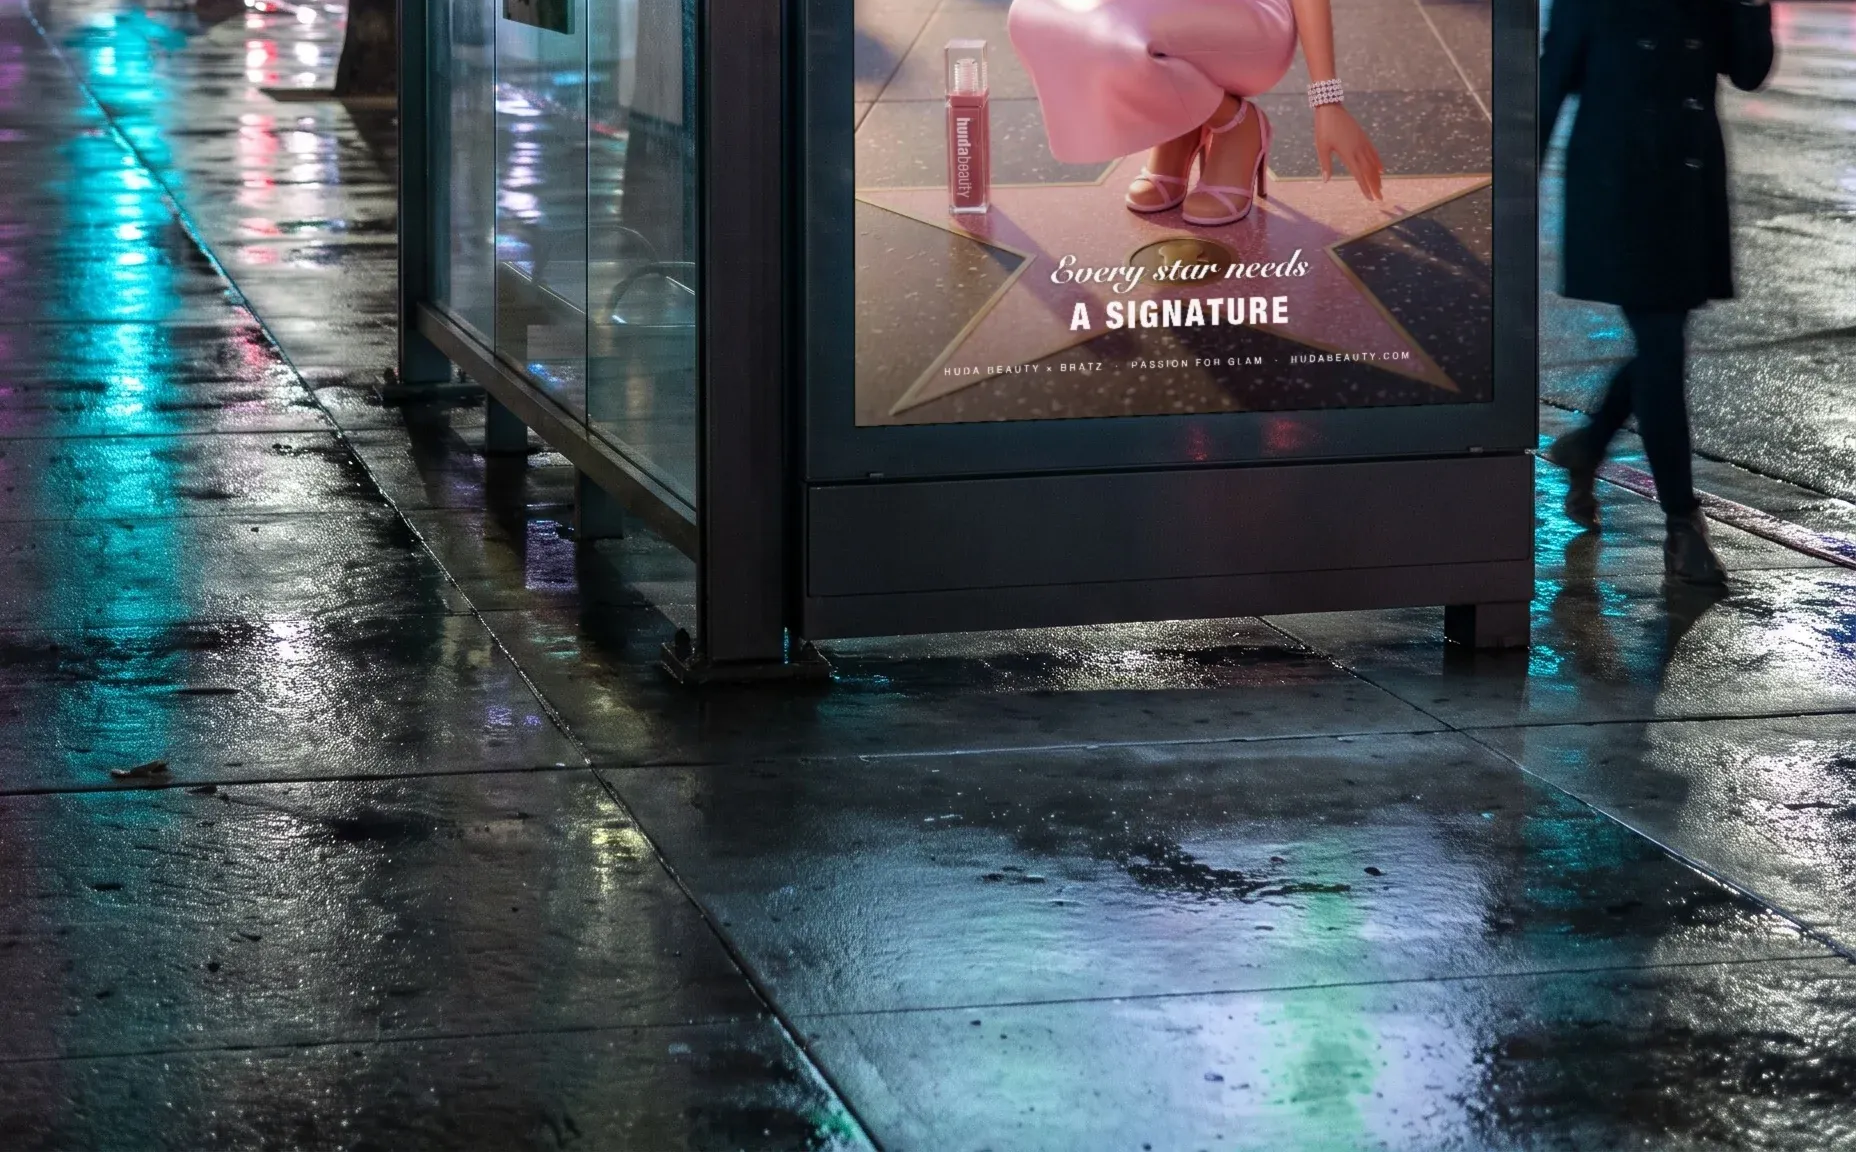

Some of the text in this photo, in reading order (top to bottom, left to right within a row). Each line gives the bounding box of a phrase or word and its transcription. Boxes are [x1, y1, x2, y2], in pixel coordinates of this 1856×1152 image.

[1050, 248, 1311, 294] Every star needs
[1070, 296, 1289, 331] A SIGNATURE
[944, 366, 980, 376] HUDA
[987, 364, 1039, 375] BEAUTY
[1060, 362, 1103, 373] BRATZ
[1131, 359, 1189, 369] PASSION
[1195, 357, 1221, 367] FOR
[1227, 356, 1263, 366] GLAM
[1290, 351, 1411, 364] HUDABEAUTY.COM
